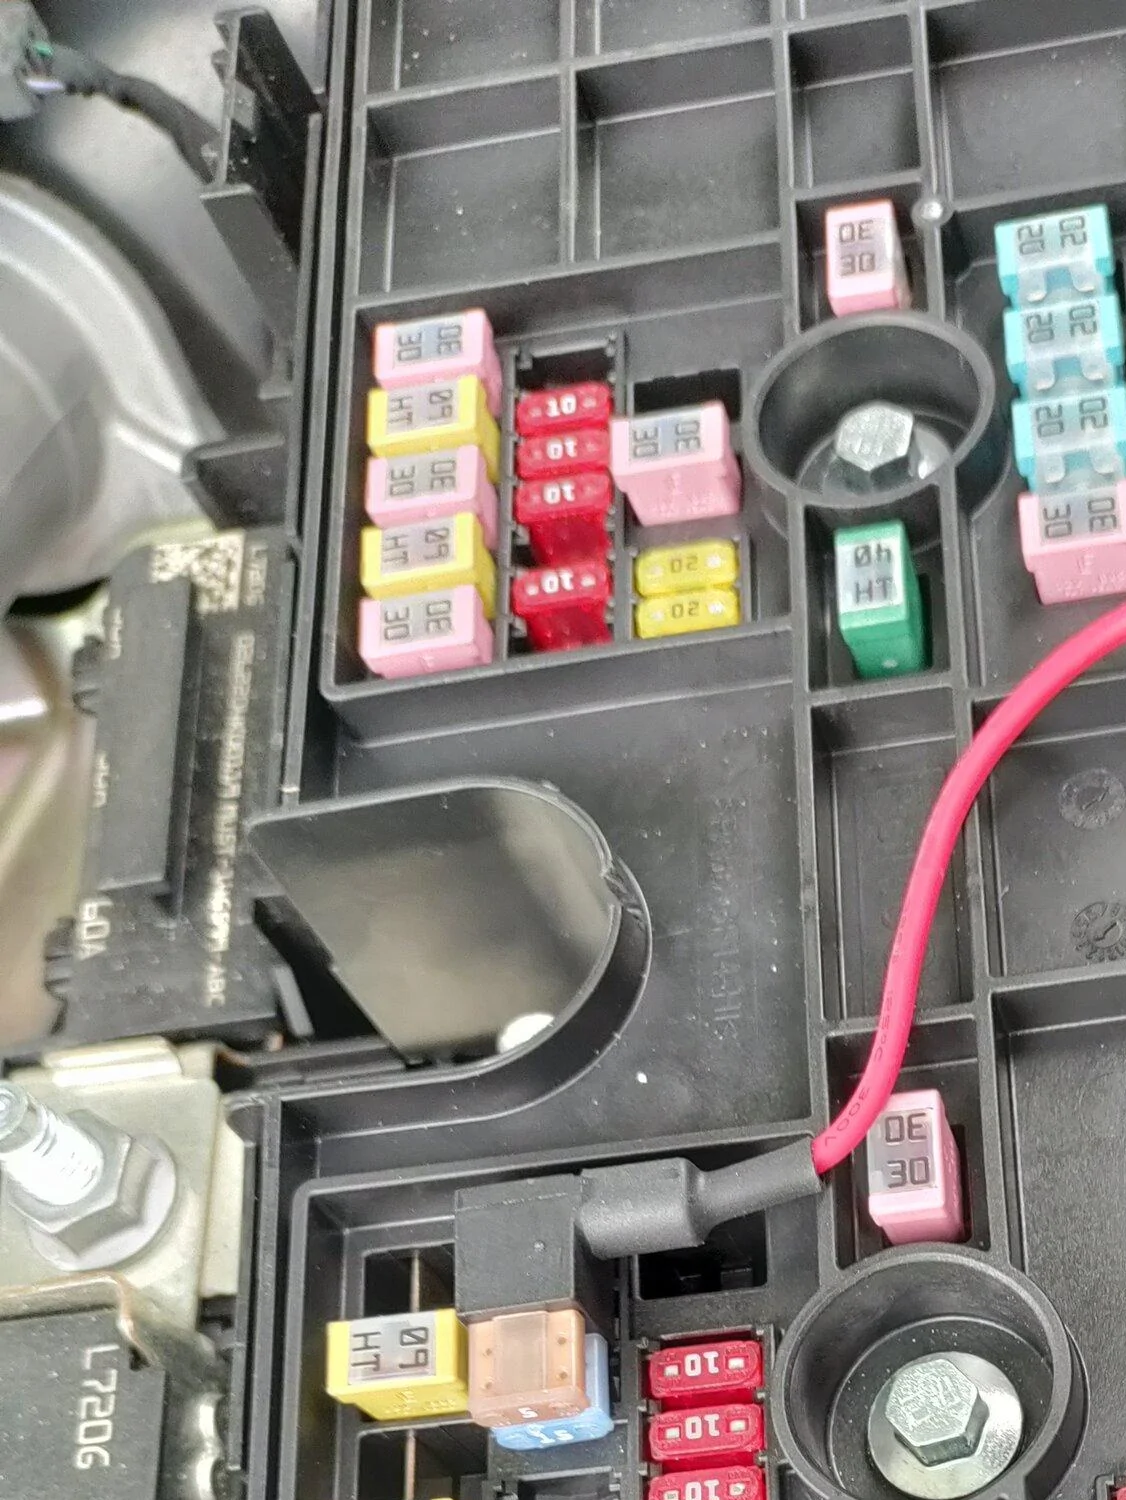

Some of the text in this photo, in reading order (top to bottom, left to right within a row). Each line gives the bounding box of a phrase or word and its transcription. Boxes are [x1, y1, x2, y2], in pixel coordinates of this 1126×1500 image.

[839, 219, 873, 242] 30
[1018, 224, 1045, 255] 20
[1060, 215, 1087, 247] 20
[840, 252, 875, 276] 30
[1027, 312, 1055, 343] 20
[1069, 304, 1097, 337] 20
[398, 332, 421, 361] 30
[437, 325, 462, 355] 30
[429, 389, 453, 420] 60
[545, 394, 577, 417] 10
[1080, 396, 1108, 430] 20
[675, 420, 700, 453] 30
[1036, 405, 1064, 438] 20
[546, 437, 577, 460] 10
[634, 426, 658, 458] 30
[390, 465, 415, 496] 30
[431, 459, 456, 490] 30
[543, 480, 575, 504] 10
[1043, 504, 1072, 537] 30
[1087, 497, 1117, 532] 30
[425, 527, 449, 560] 60
[671, 556, 698, 573] 20
[542, 570, 574, 593] 10
[384, 606, 409, 641] 30
[426, 600, 452, 633] 30
[671, 601, 699, 619] 20
[885, 1112, 927, 1143] 30
[887, 1157, 929, 1188] 30
[352, 1331, 381, 1371] HT
[399, 1326, 428, 1369] 60
[684, 1351, 719, 1377] 10
[685, 1413, 720, 1440] 10
